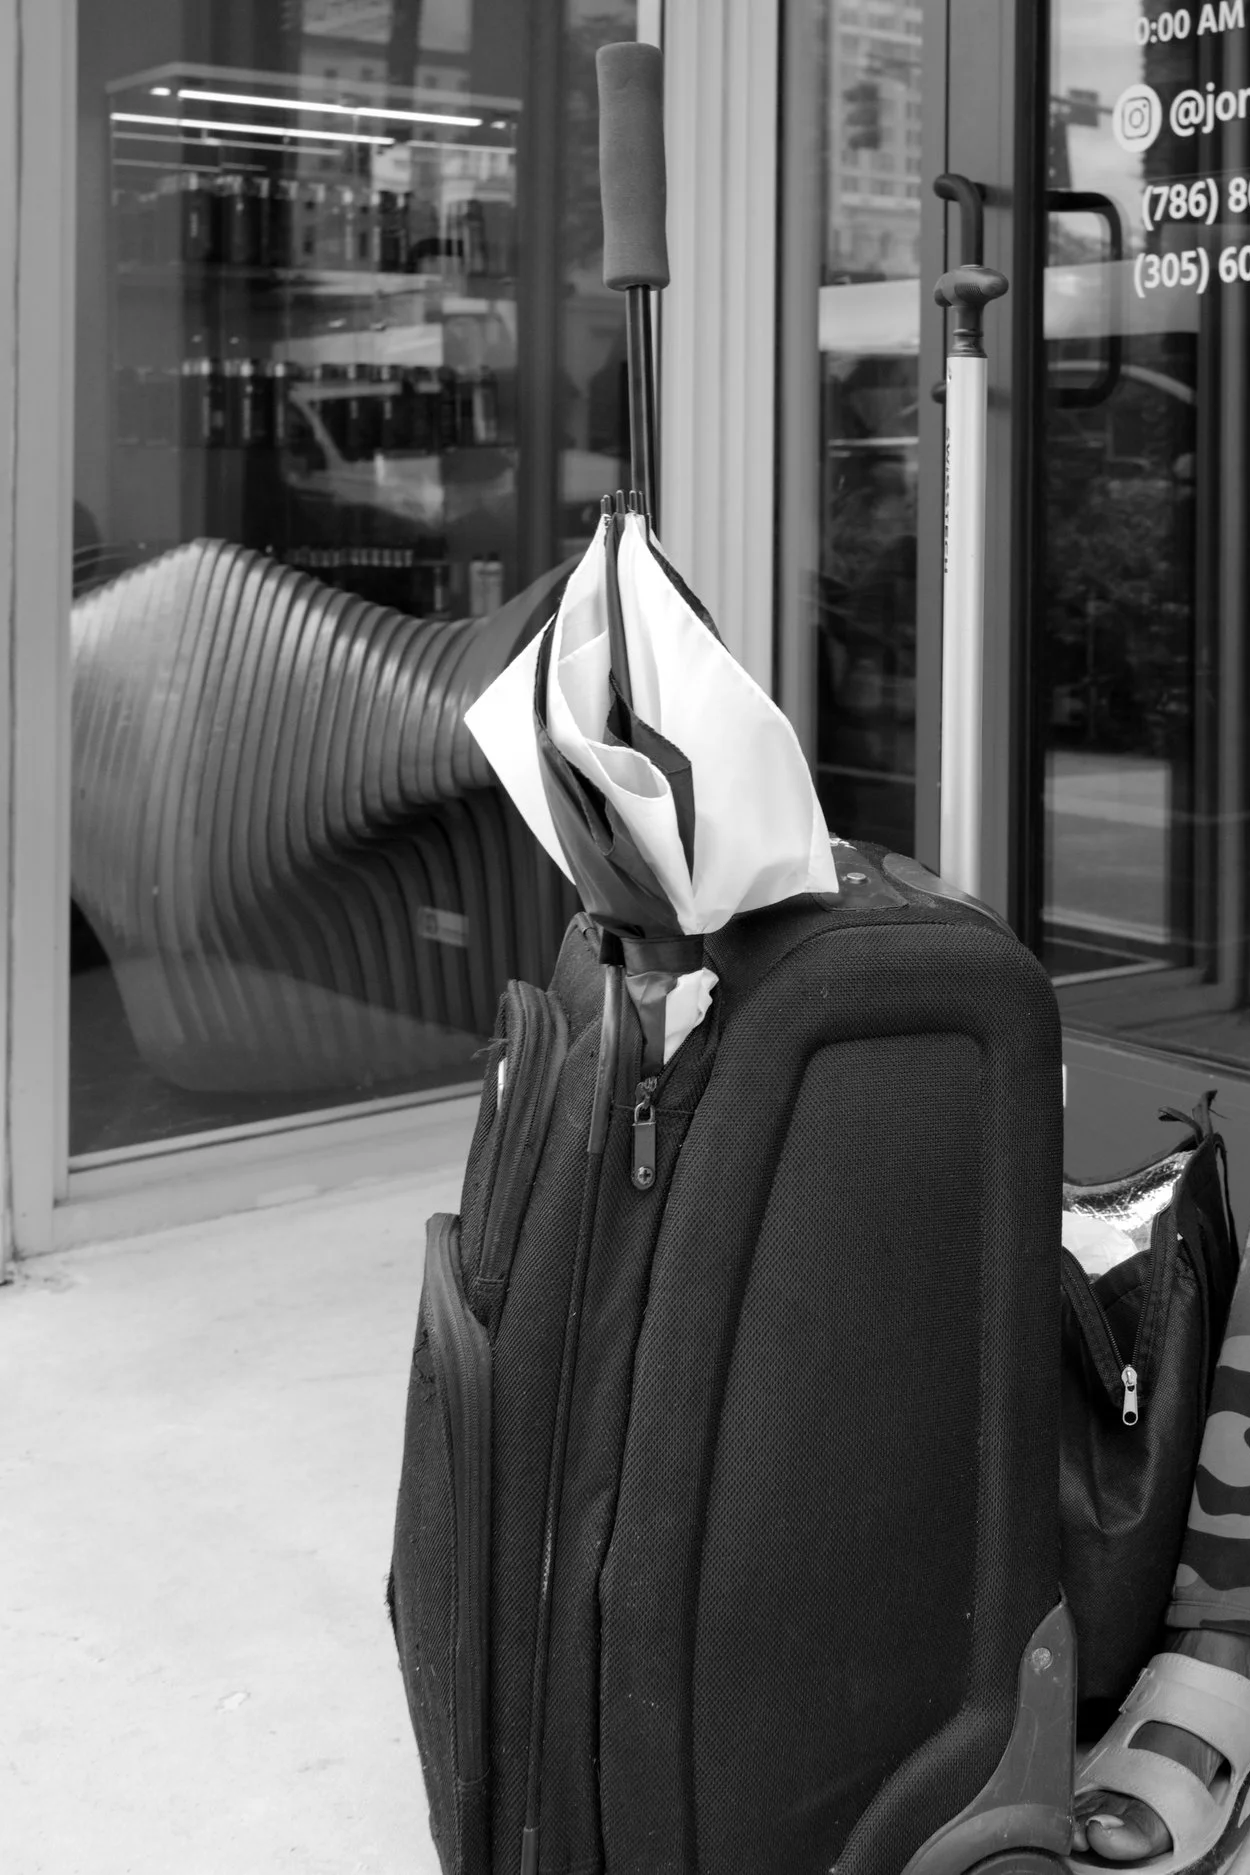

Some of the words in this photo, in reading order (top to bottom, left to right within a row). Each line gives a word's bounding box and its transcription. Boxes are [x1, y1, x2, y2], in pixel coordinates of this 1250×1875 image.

[1197, 0, 1245, 36] AM
[1142, 178, 1219, 231] (786)
[1134, 247, 1210, 298] (305)
